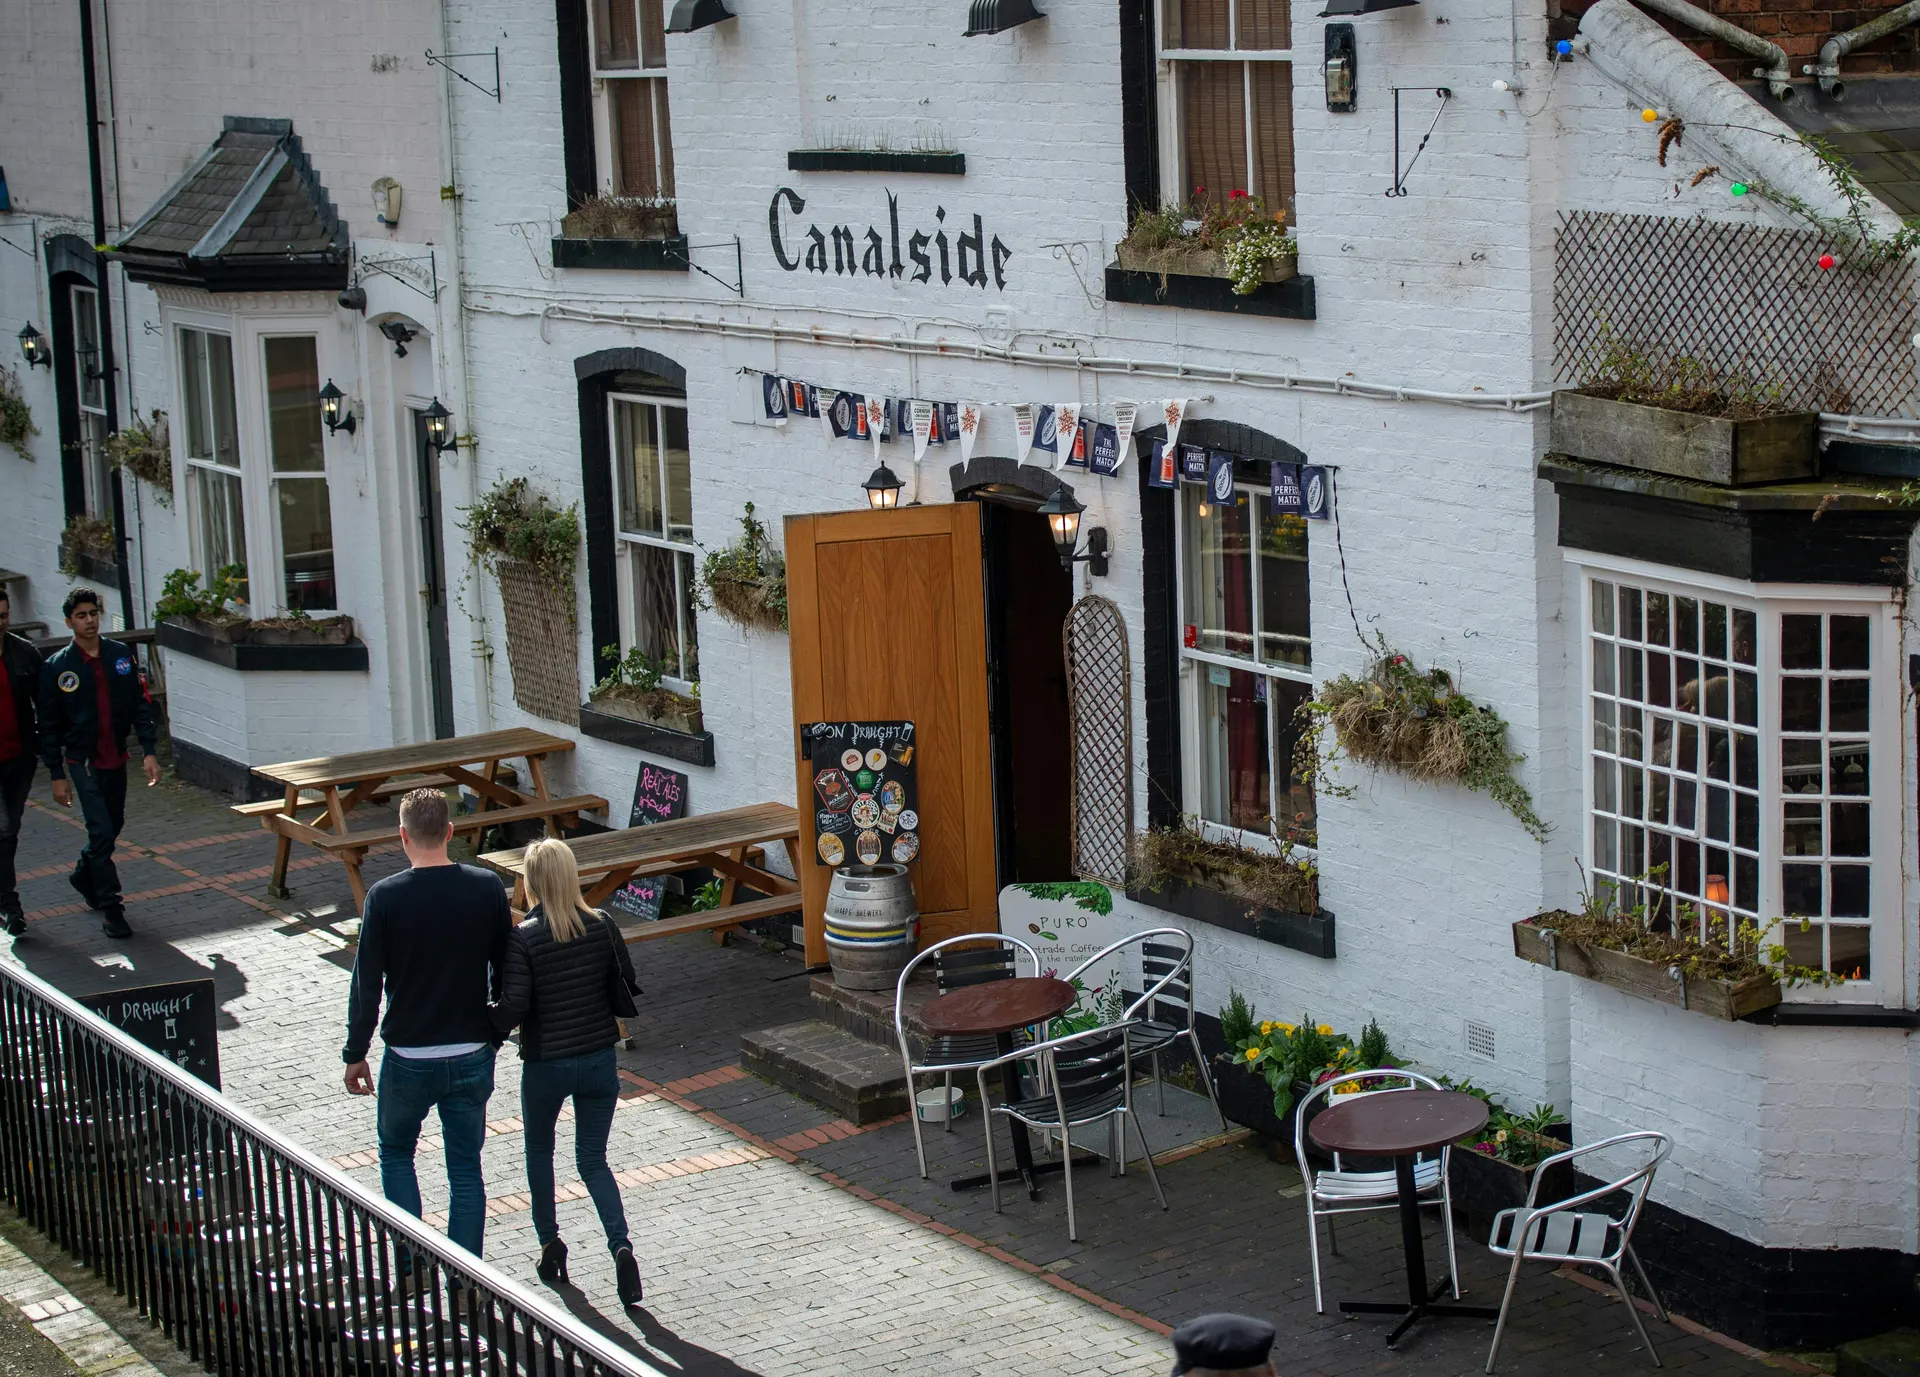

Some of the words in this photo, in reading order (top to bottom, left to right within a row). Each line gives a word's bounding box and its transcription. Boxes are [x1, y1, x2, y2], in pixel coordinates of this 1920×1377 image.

[769, 187, 1013, 292] Canalside
[946, 414, 958, 423] PERF
[1103, 437, 1112, 448] THE
[1096, 456, 1115, 467] MATCH
[1186, 452, 1205, 461] PERFECT
[1188, 462, 1205, 472] MATCH
[1283, 475, 1294, 484] THE
[1274, 485, 1299, 494] PERFEC
[1278, 495, 1301, 504] MATCH
[851, 723, 901, 739] DRAUGHT
[640, 767, 661, 796] REAL
[662, 782, 681, 802] ALES
[856, 908, 882, 917] BREWERY
[1039, 916, 1088, 929] PURO
[1017, 944, 1065, 954] Fartrade
[1071, 943, 1104, 953] Coffee
[1065, 954, 1105, 962] rainfot
[120, 993, 194, 1027] DRAUGHT
